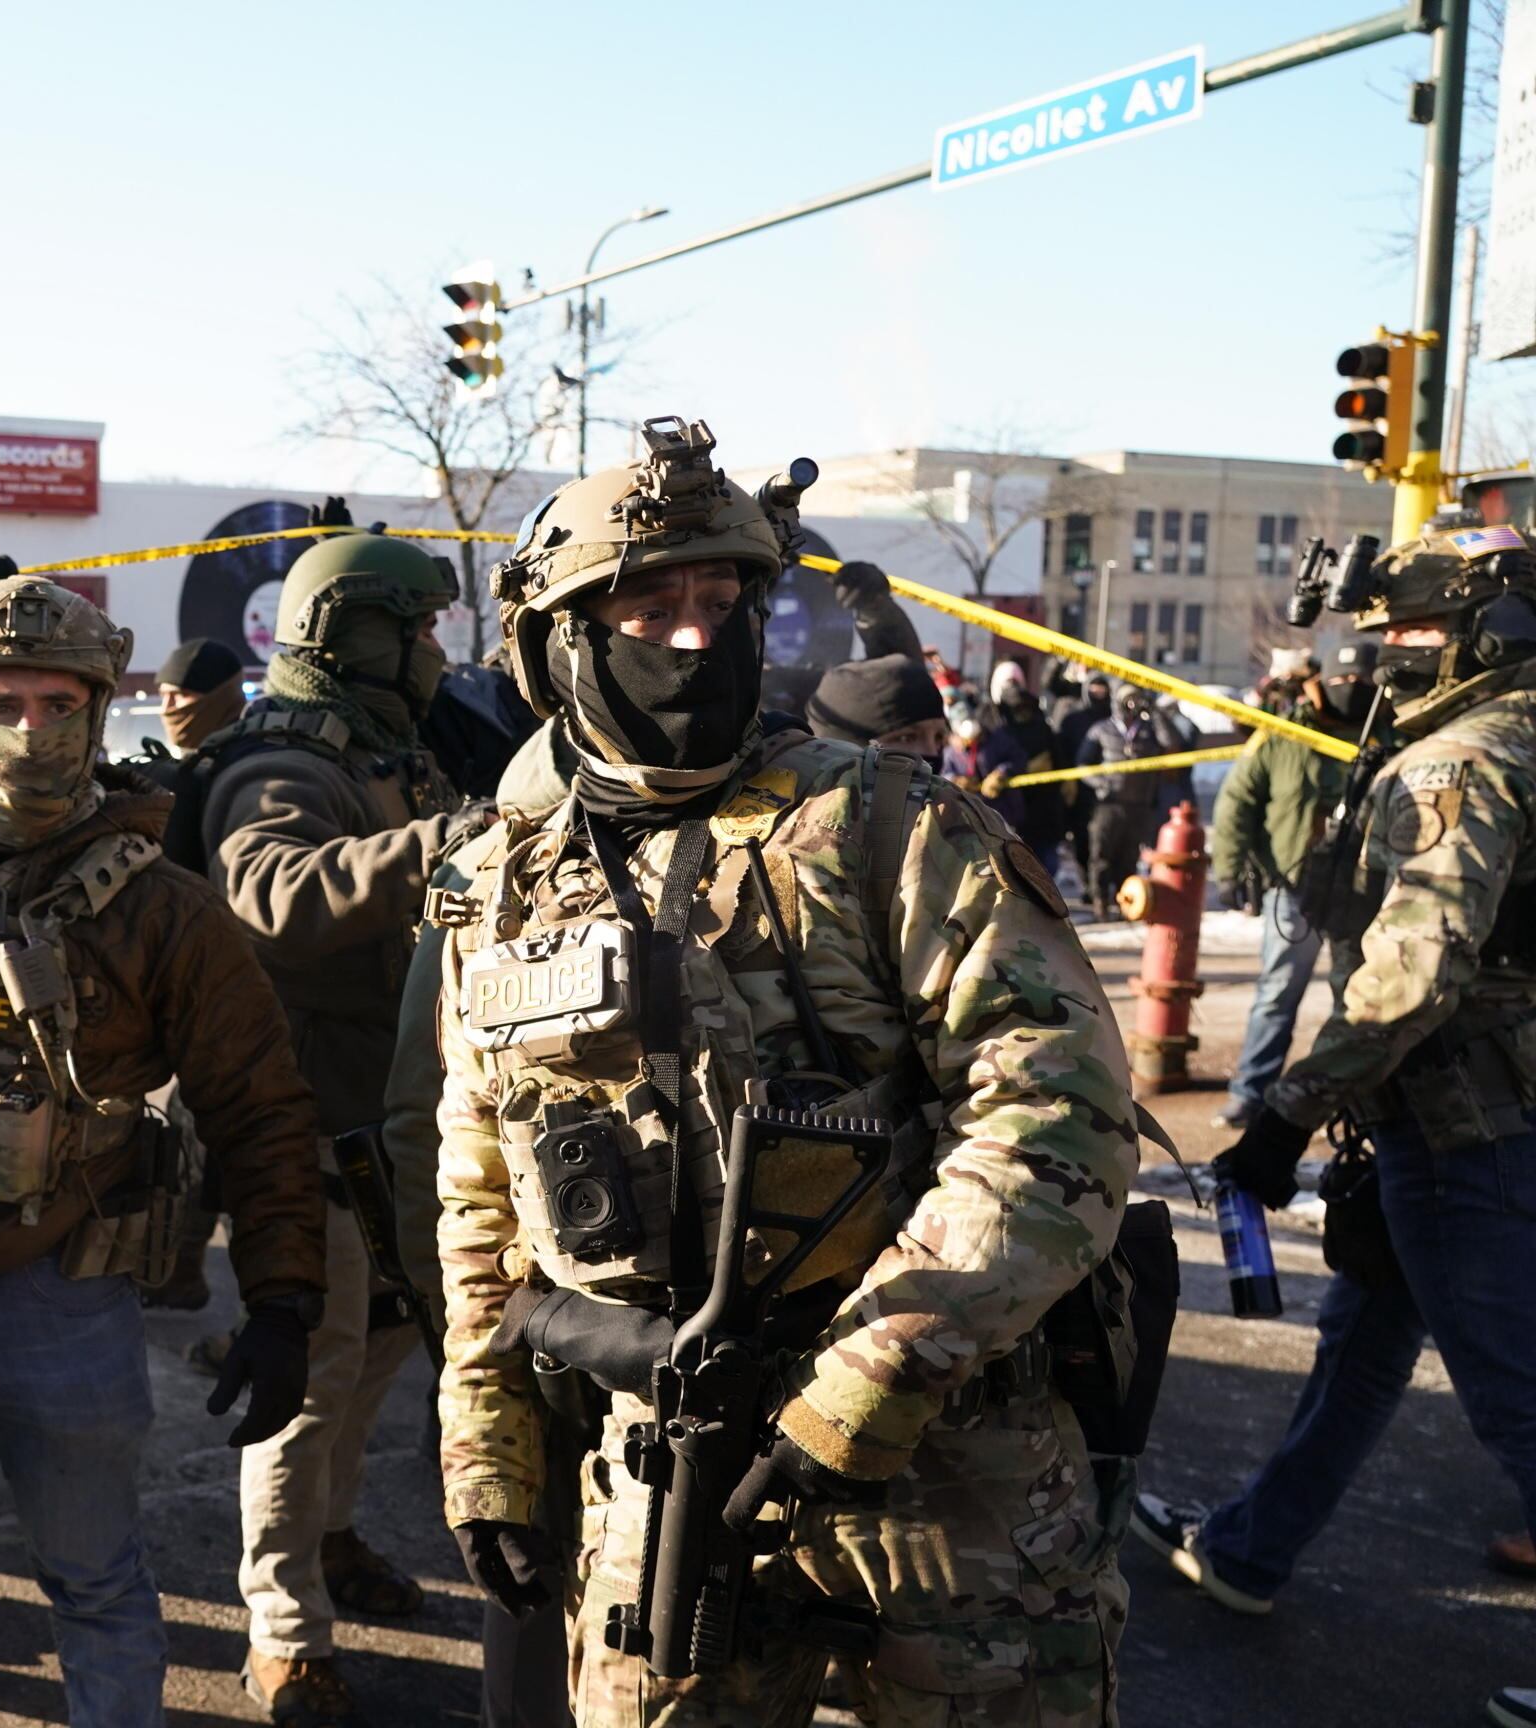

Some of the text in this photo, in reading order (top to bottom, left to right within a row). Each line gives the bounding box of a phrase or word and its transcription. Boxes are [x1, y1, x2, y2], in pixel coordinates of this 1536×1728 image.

[946, 76, 1186, 174] Nicollet Av
[476, 954, 594, 1018] POLICE
